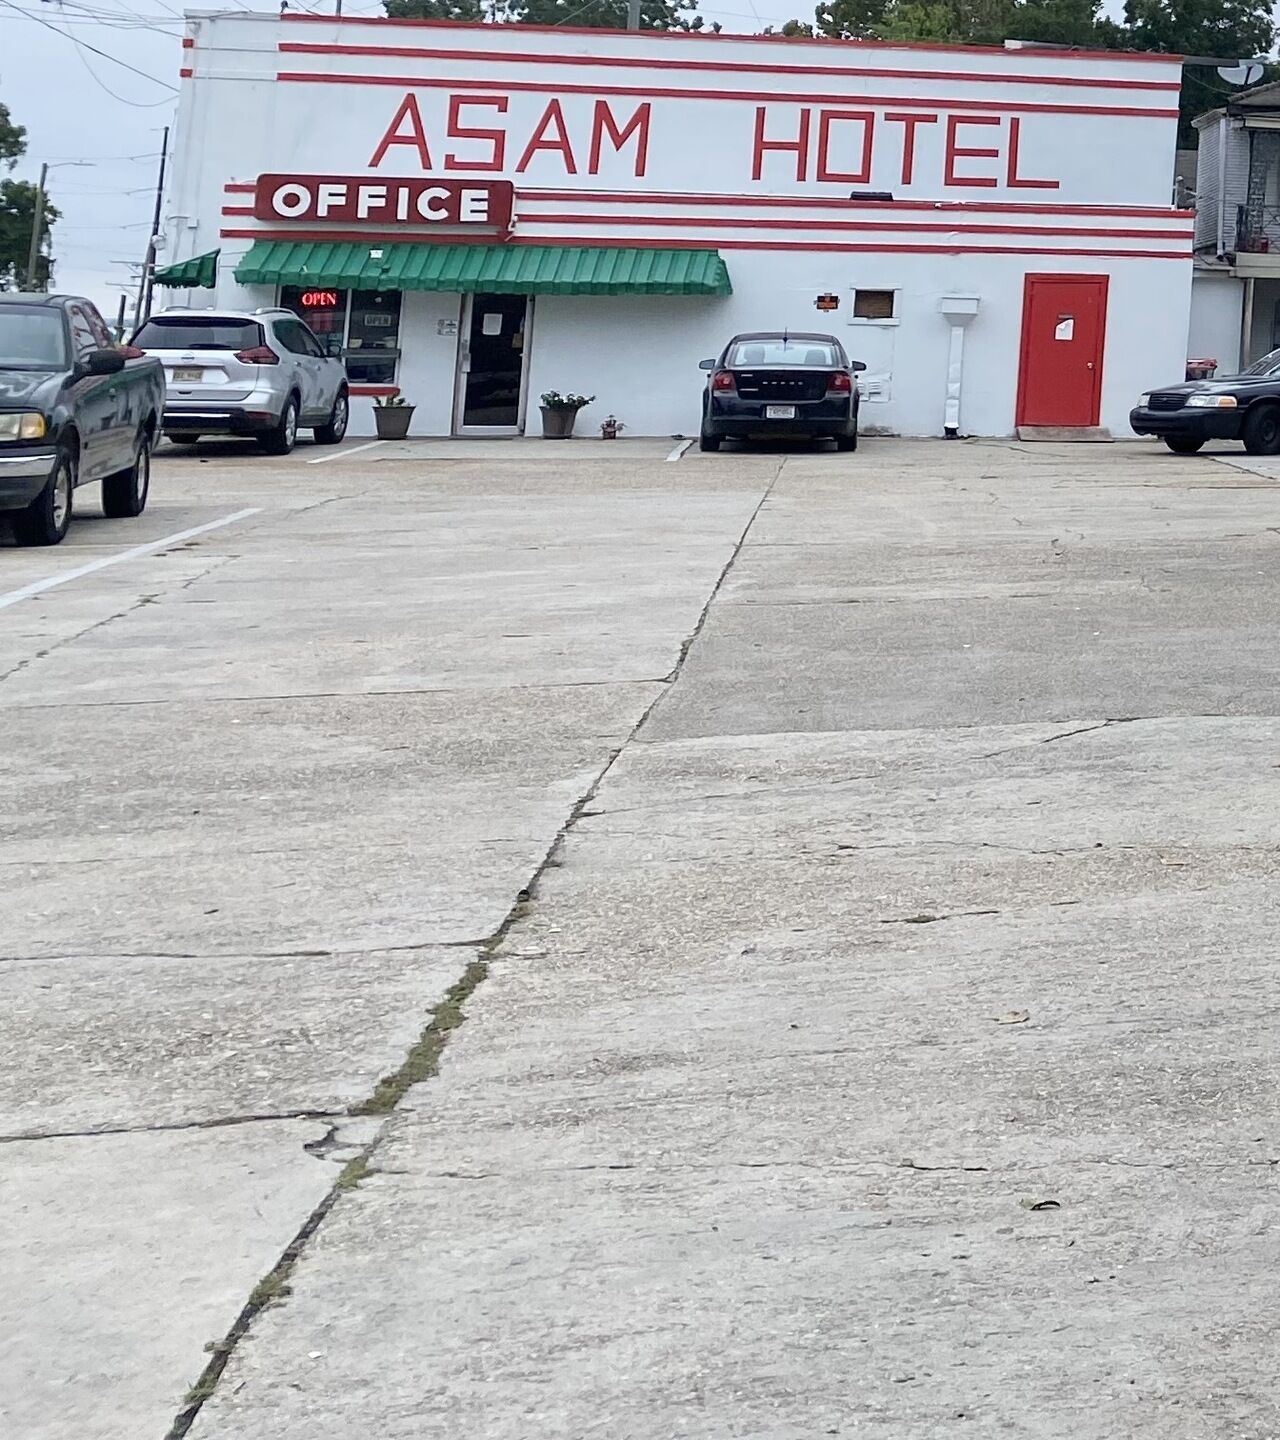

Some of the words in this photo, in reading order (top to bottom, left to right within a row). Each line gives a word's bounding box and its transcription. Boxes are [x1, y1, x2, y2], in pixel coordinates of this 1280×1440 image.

[367, 92, 651, 177] ASAM
[751, 106, 1060, 189] HOTEL
[272, 183, 489, 222] OFFICE
[301, 292, 337, 306] OPEN
